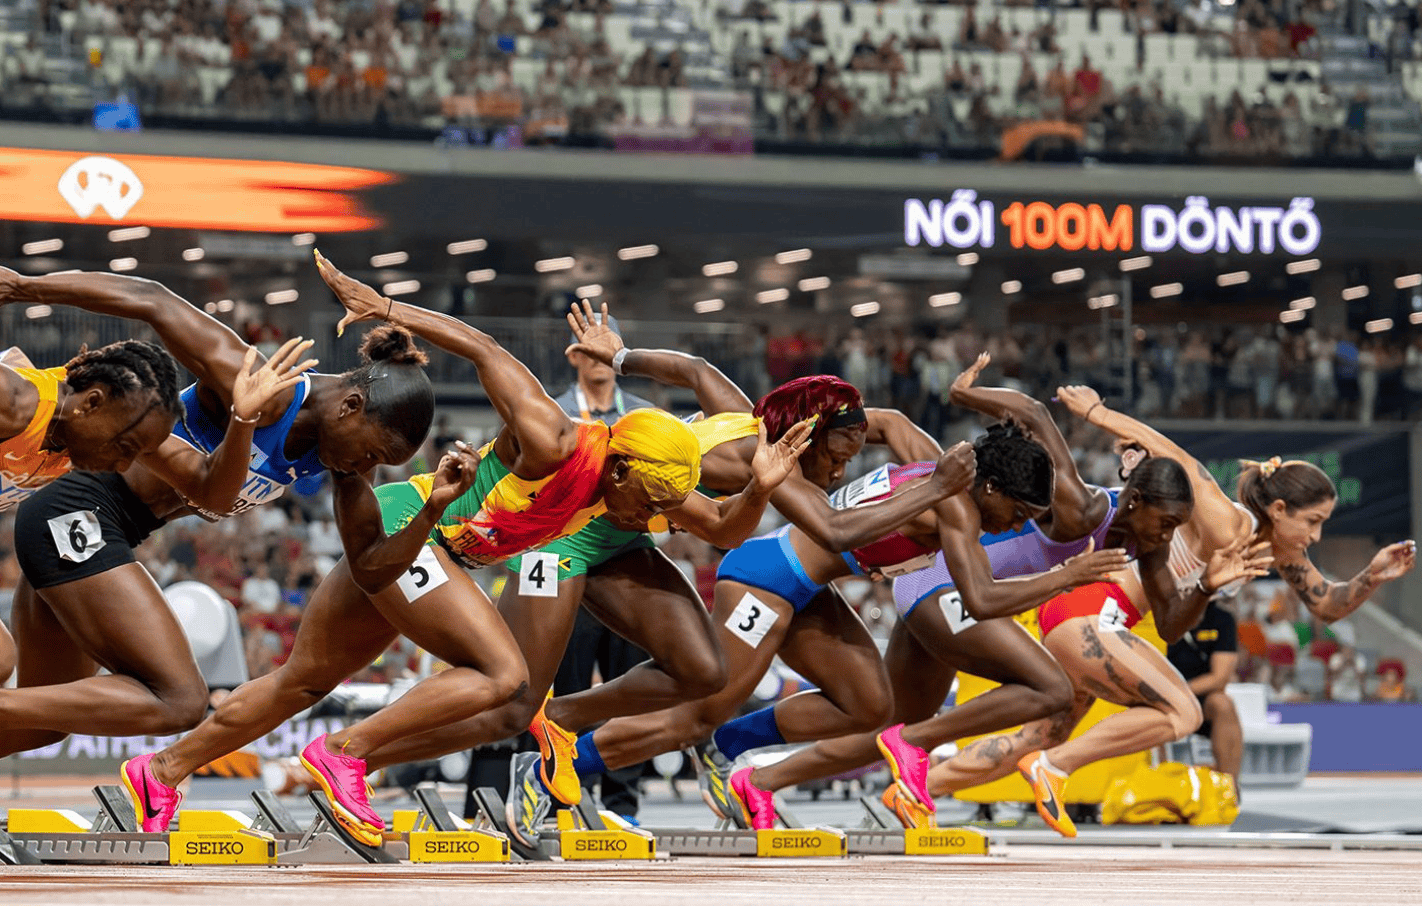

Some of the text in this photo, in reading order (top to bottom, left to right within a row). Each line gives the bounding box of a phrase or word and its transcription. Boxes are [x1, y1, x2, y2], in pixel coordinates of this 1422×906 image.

[904, 189, 1321, 255] NŐI 100M DÖNTŐ
[69, 519, 88, 553] 6
[528, 559, 546, 589] 4
[737, 604, 762, 633] 3
[186, 841, 244, 855] SEIKO
[425, 840, 481, 854] SEIKO
[575, 839, 627, 851] SEIKO
[772, 837, 822, 849] SEIKO
[918, 836, 966, 848] SEIKO
